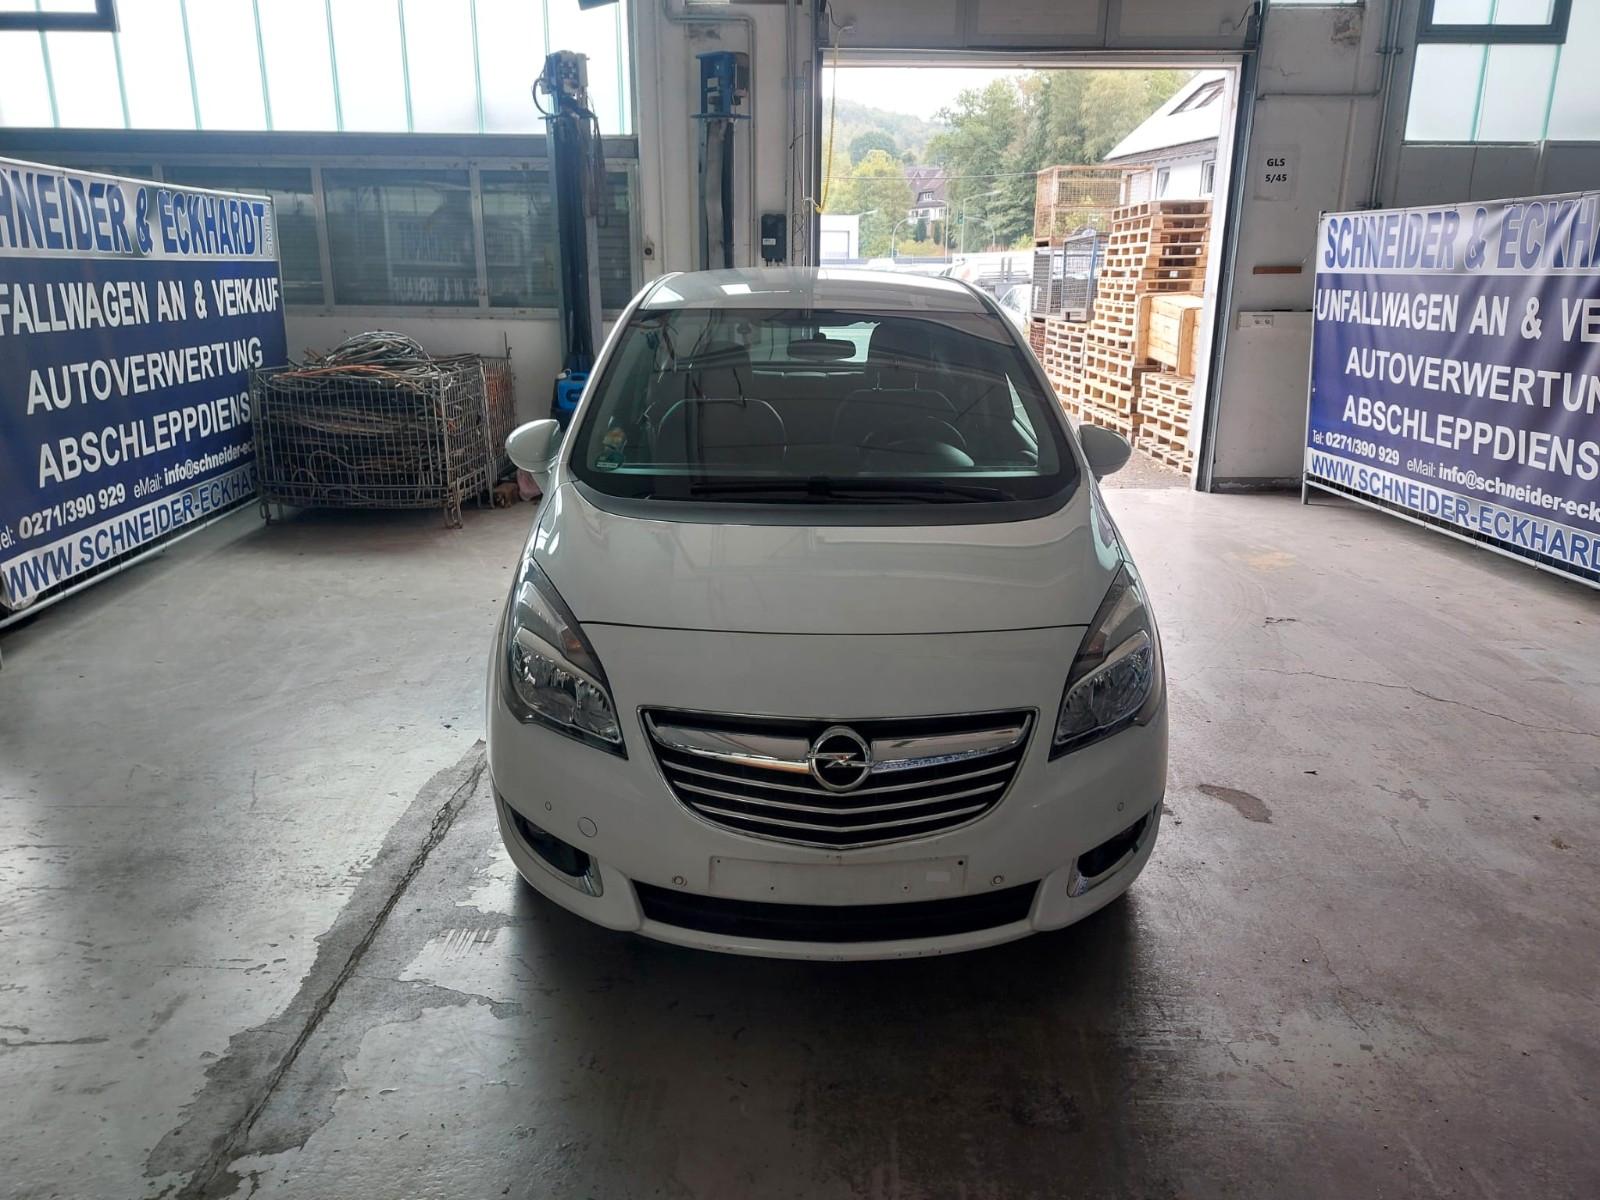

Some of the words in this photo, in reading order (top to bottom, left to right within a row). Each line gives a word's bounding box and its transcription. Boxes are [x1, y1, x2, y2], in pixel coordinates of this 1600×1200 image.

[1265, 173, 1287, 183] 5/45
[1266, 158, 1285, 167] GLS
[136, 187, 153, 256] &
[157, 190, 265, 256] ECKHARDT
[1324, 210, 1461, 269] SCHNEIDER
[1464, 207, 1489, 270] &
[157, 281, 187, 322] AN
[194, 280, 208, 319] &
[211, 277, 280, 317] VERKAUF
[1316, 288, 1459, 332] UNFALLWAGEN
[1468, 296, 1509, 336] AN
[1520, 297, 1542, 340] &
[1561, 298, 1600, 343] VE
[27, 337, 263, 415] AUTOVERWERTUNG
[39, 391, 250, 488] ABSCHLEPPDIENS
[1326, 432, 1376, 458] 0271/390
[1379, 446, 1400, 466] 929
[1407, 457, 1436, 478] eMail:
[1343, 395, 1600, 481] ABSCHLEPPDIENS
[0, 525, 16, 551] el:
[19, 494, 95, 539] 0271/390
[98, 484, 126, 510] 929
[133, 474, 163, 499] eMail:
[164, 439, 255, 486] info@schneider-ec
